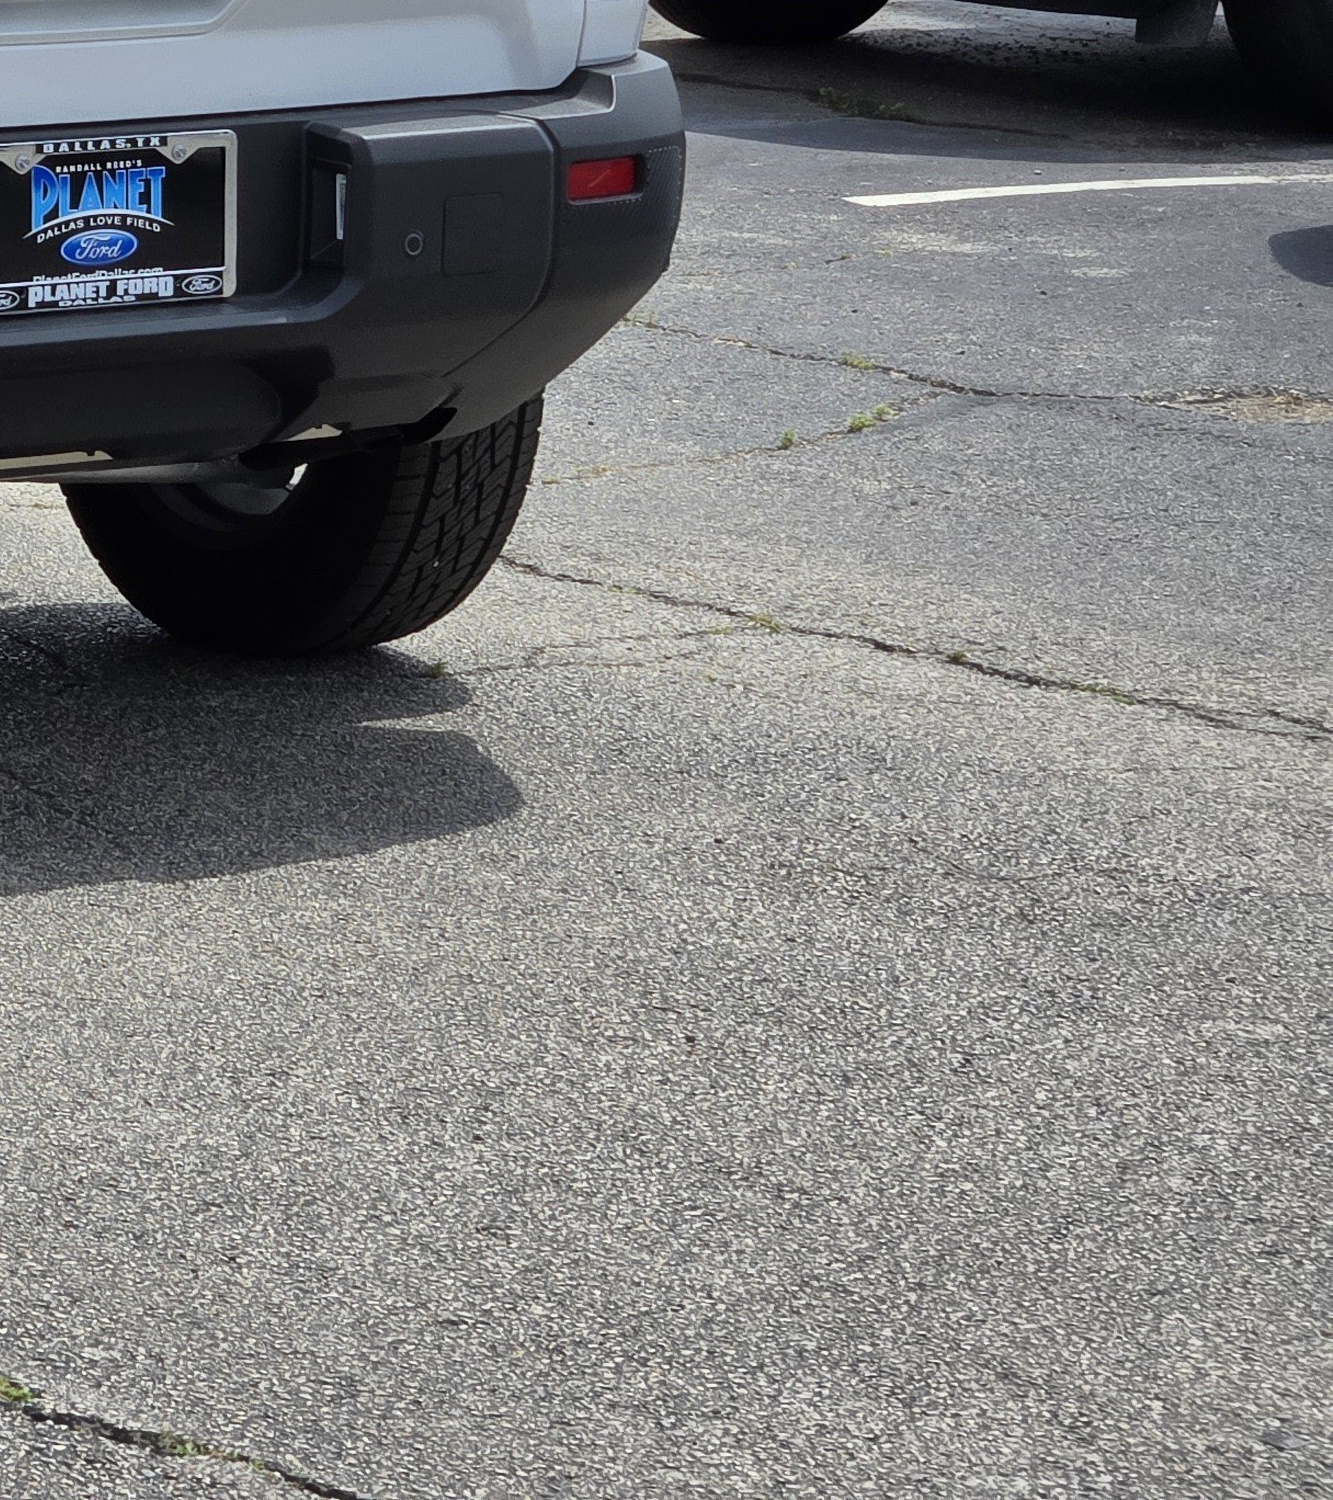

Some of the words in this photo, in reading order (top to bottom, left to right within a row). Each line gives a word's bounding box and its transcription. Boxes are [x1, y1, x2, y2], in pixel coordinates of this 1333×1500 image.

[136, 136, 161, 147] TX
[55, 163, 102, 173] RANDALL
[106, 159, 142, 170] REED'S
[31, 165, 166, 231] PLANET
[36, 219, 84, 243] DALLAS
[90, 216, 122, 226] LOVE
[126, 217, 161, 233] FIELD
[75, 235, 122, 260] Ford
[28, 281, 110, 308] PLANET
[116, 275, 174, 297] FORD
[190, 278, 215, 291] Ford
